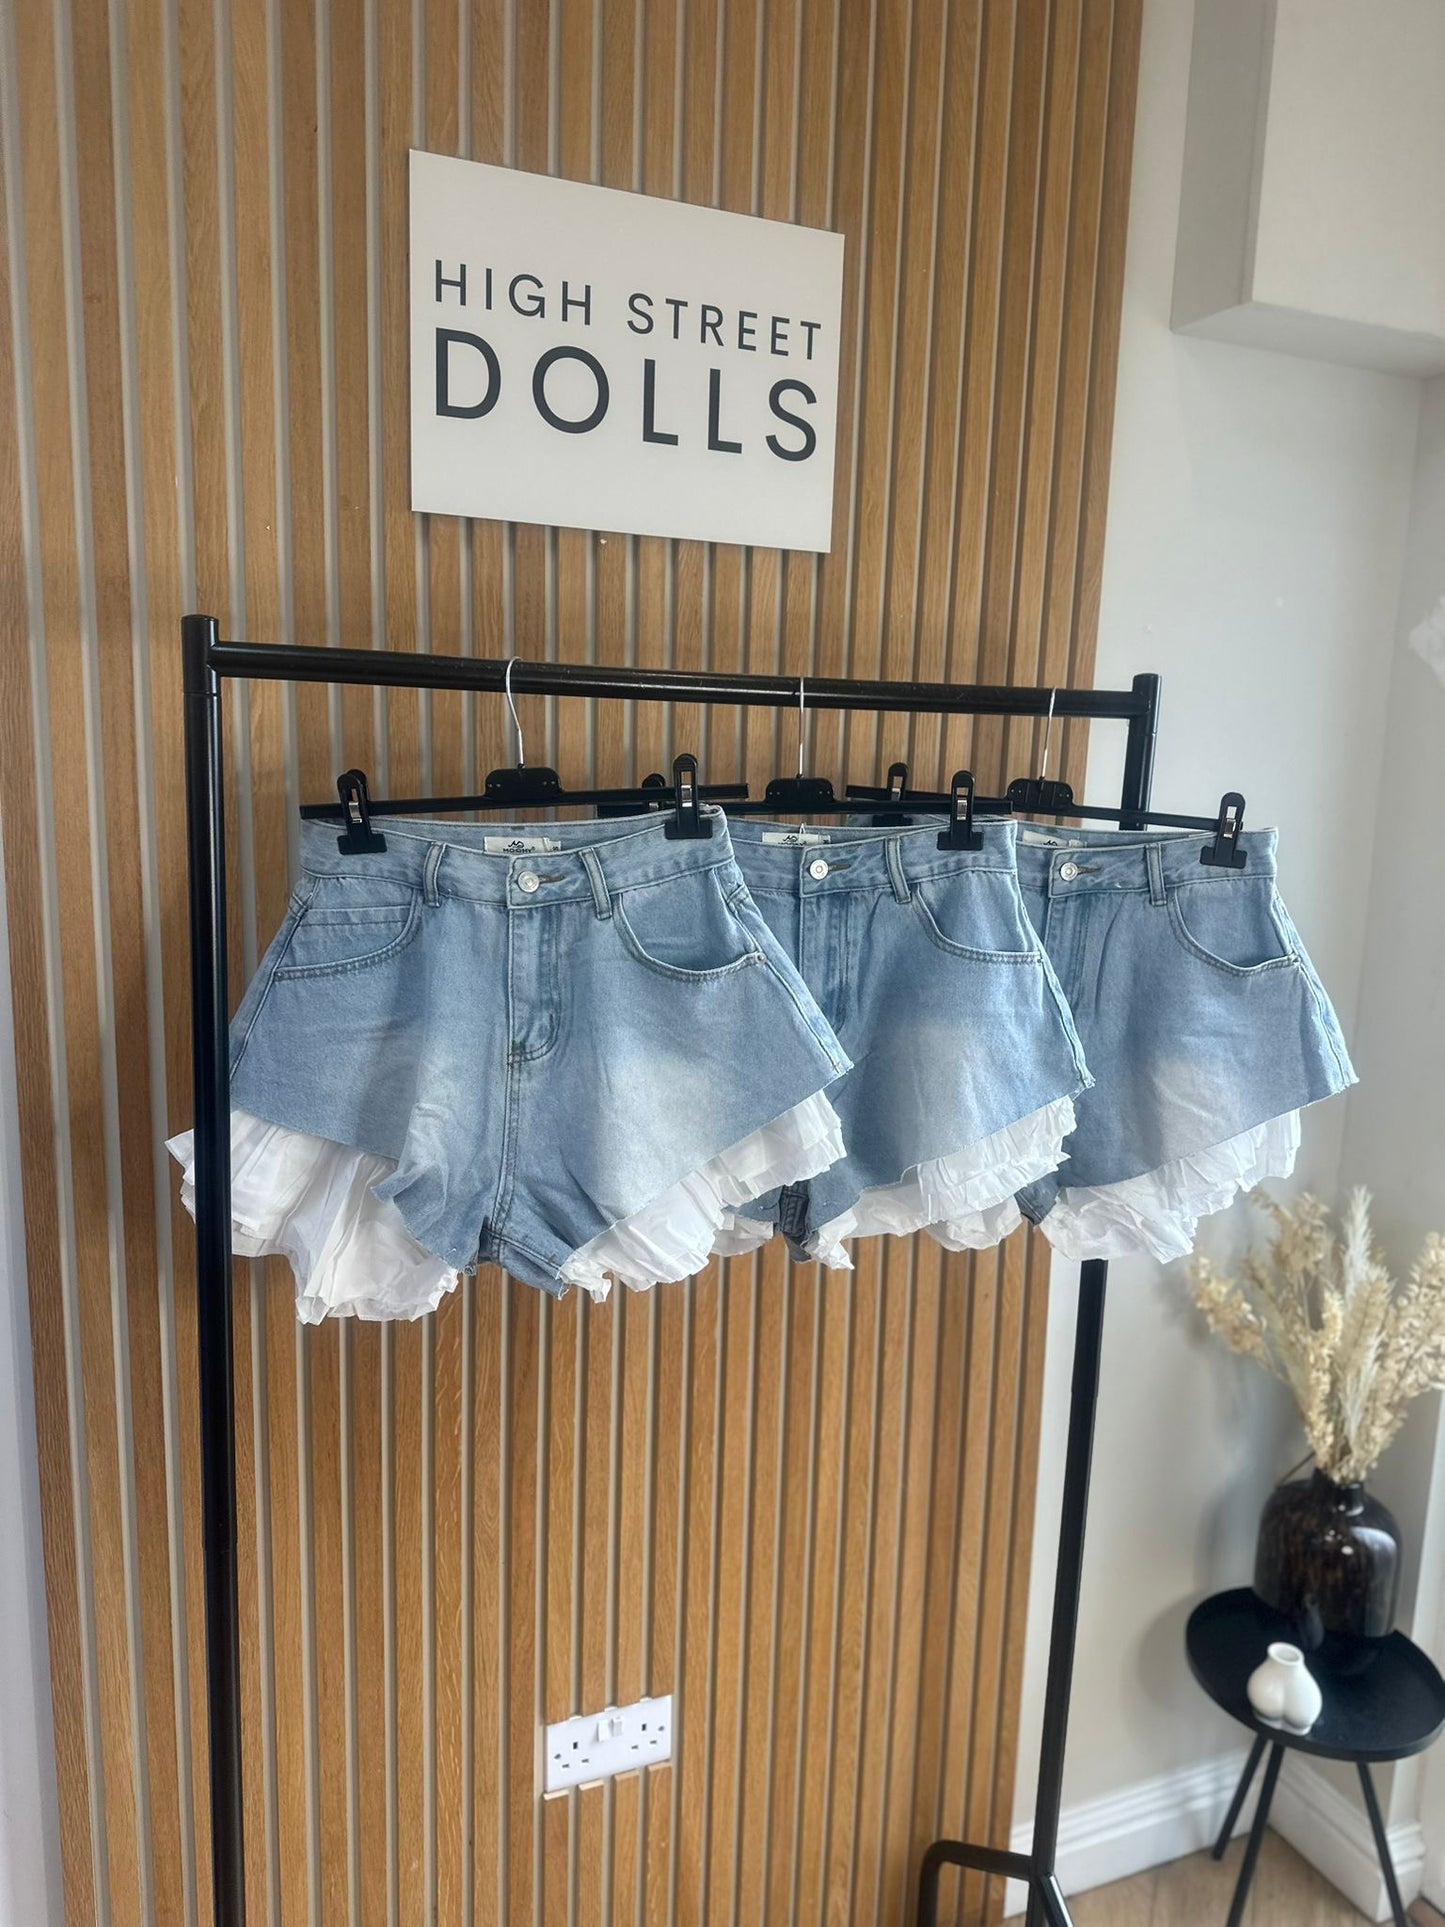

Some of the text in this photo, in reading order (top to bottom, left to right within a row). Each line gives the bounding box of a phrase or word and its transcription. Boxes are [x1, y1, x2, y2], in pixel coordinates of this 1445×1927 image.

[435, 259, 822, 360] HIGH STREET
[435, 327, 818, 462] DOLLS
